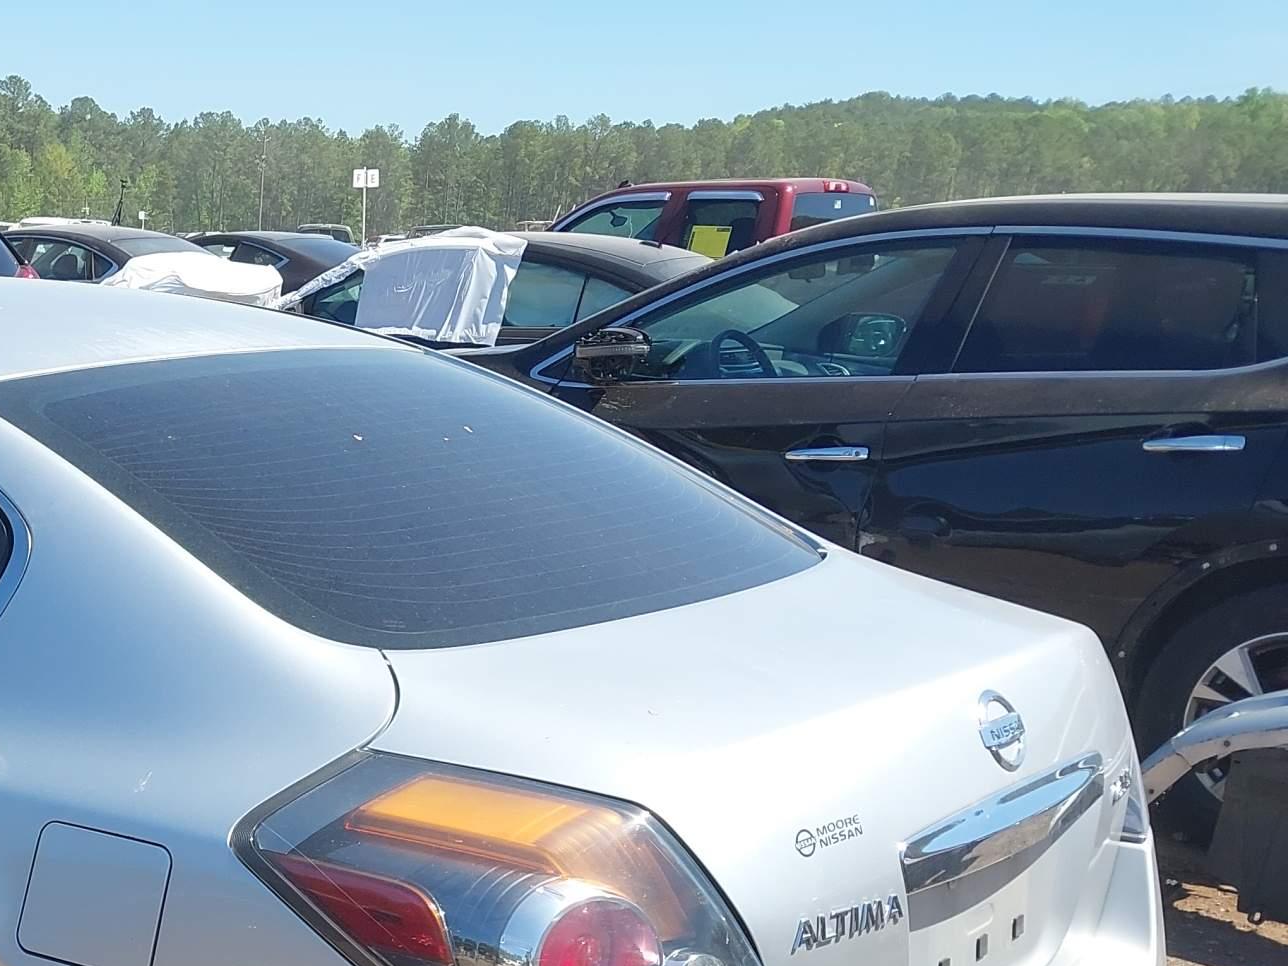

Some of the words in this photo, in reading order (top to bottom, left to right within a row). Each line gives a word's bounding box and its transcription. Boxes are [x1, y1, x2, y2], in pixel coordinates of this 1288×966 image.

[816, 813, 861, 837] MOORE
[819, 824, 864, 849] NISSAN
[791, 894, 904, 955] ALTIMA
